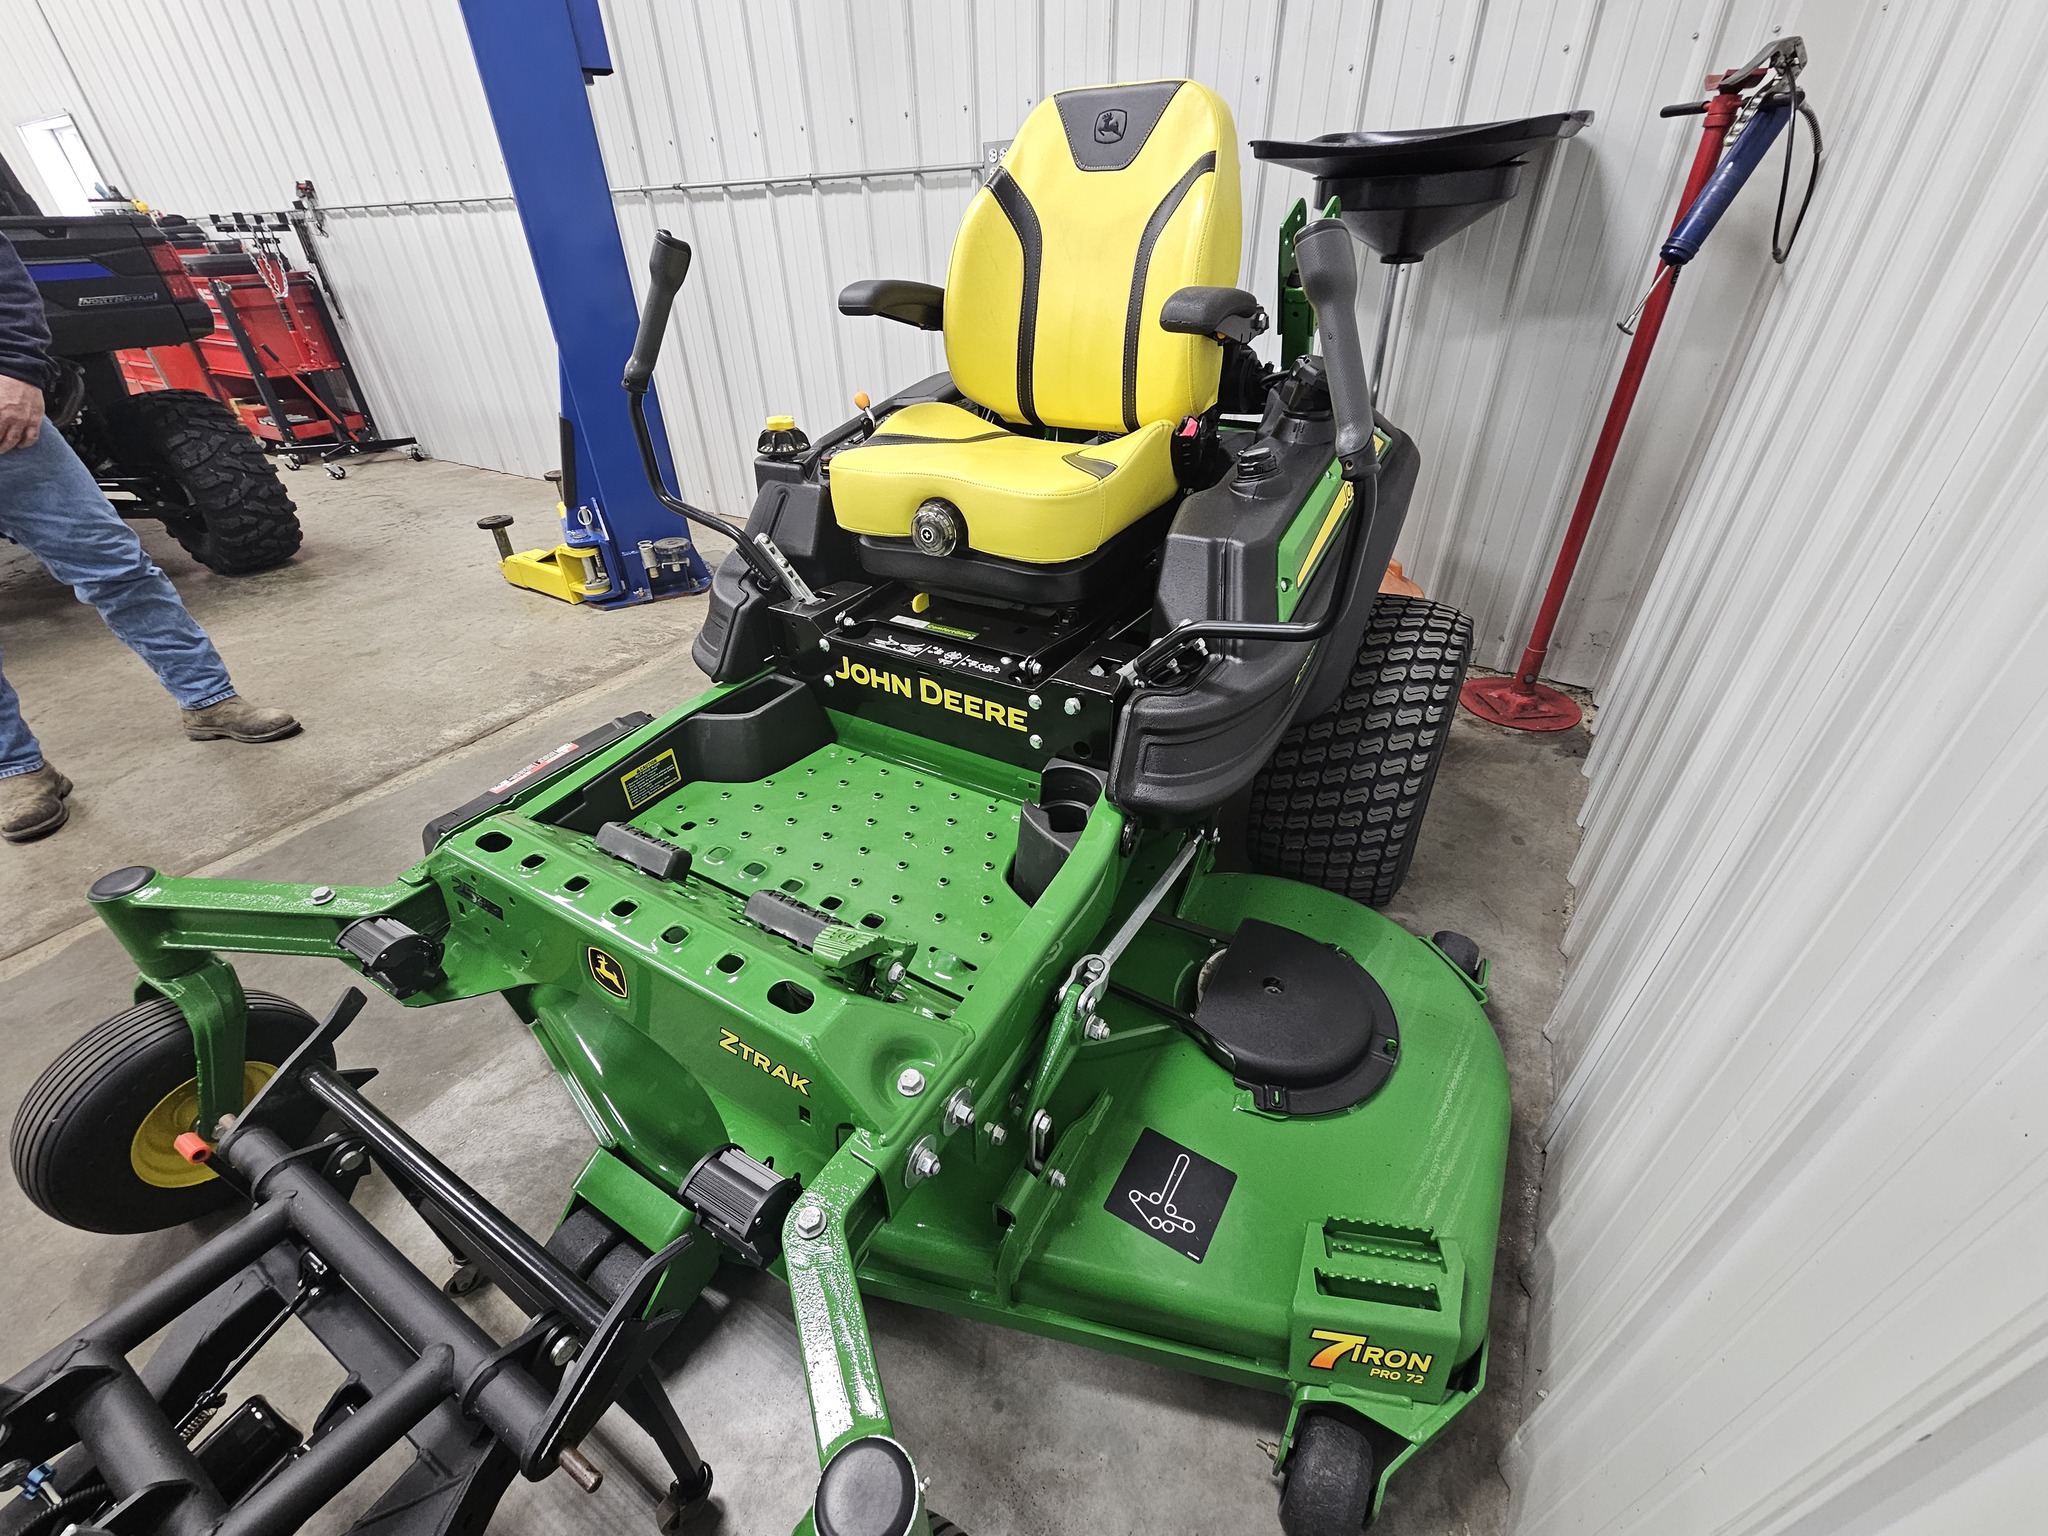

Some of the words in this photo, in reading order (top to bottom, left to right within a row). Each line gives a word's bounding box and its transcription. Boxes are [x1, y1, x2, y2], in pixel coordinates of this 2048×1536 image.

[835, 656, 912, 698] JOHN
[919, 677, 1028, 732] DEERE
[719, 1028, 811, 1097] ZTRAK
[1369, 1367, 1402, 1380] PRO
[1405, 1373, 1425, 1384] 72
